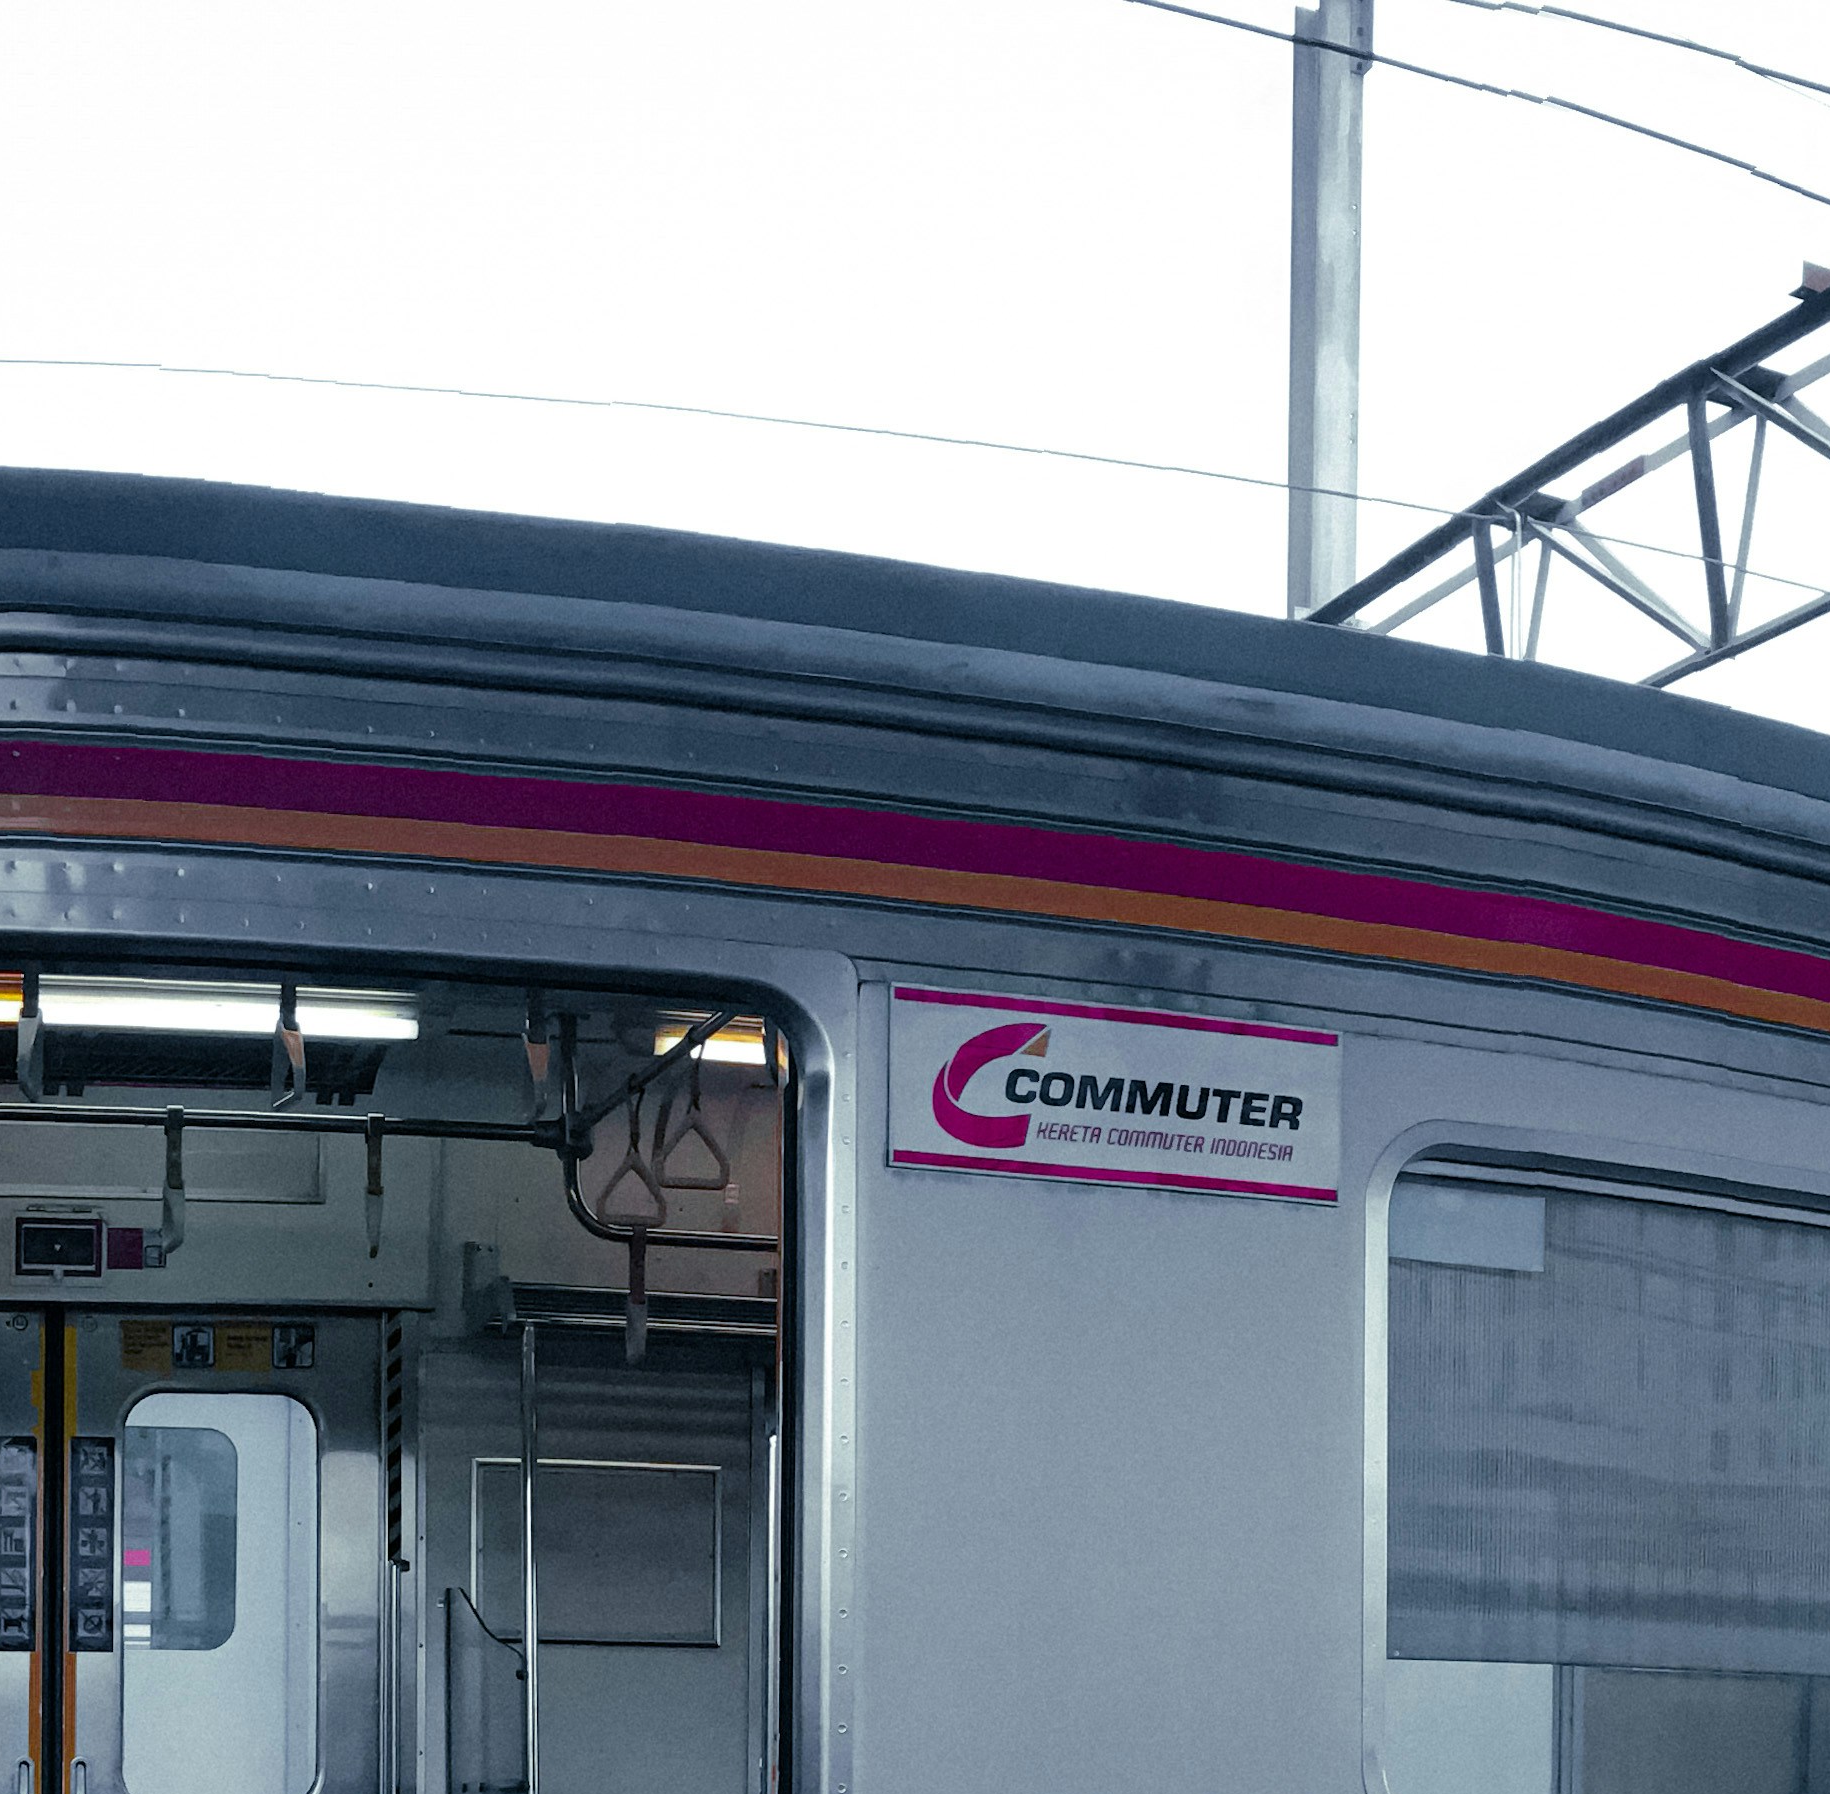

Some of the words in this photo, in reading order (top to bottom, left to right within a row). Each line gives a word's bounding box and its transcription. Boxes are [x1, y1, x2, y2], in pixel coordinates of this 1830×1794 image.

[1004, 1066, 1304, 1131] COMMUTER
[1035, 1121, 1101, 1145] KERETA
[1106, 1126, 1205, 1154] COMMUTER
[1209, 1137, 1294, 1162] INDONESIA
